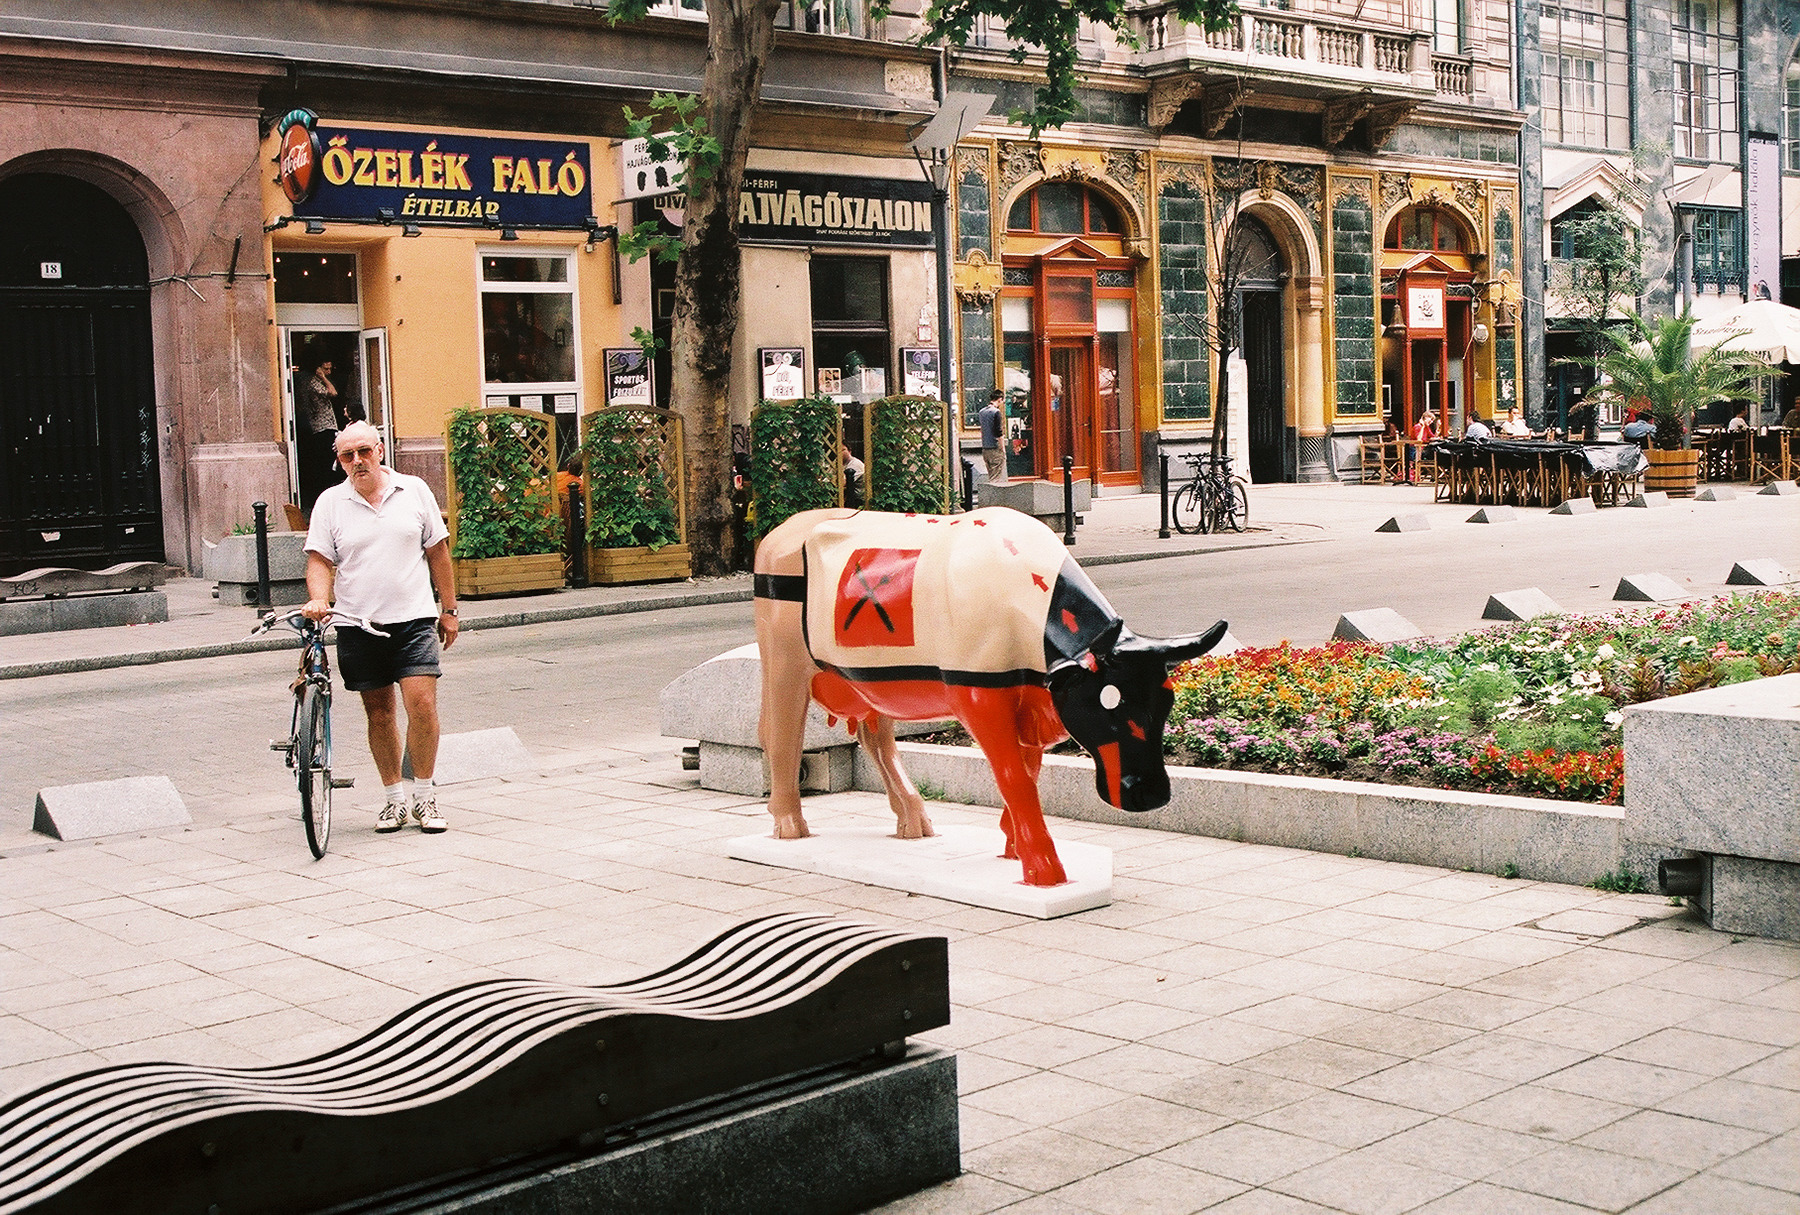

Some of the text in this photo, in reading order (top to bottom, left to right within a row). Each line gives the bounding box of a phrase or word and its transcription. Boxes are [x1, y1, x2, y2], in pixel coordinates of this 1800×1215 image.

[322, 134, 586, 196] ŐZELÉK FALÓ
[741, 178, 778, 190] I-FÉRFI
[738, 189, 932, 232] AJVÁGÓSZALON
[45, 264, 57, 274] 18
